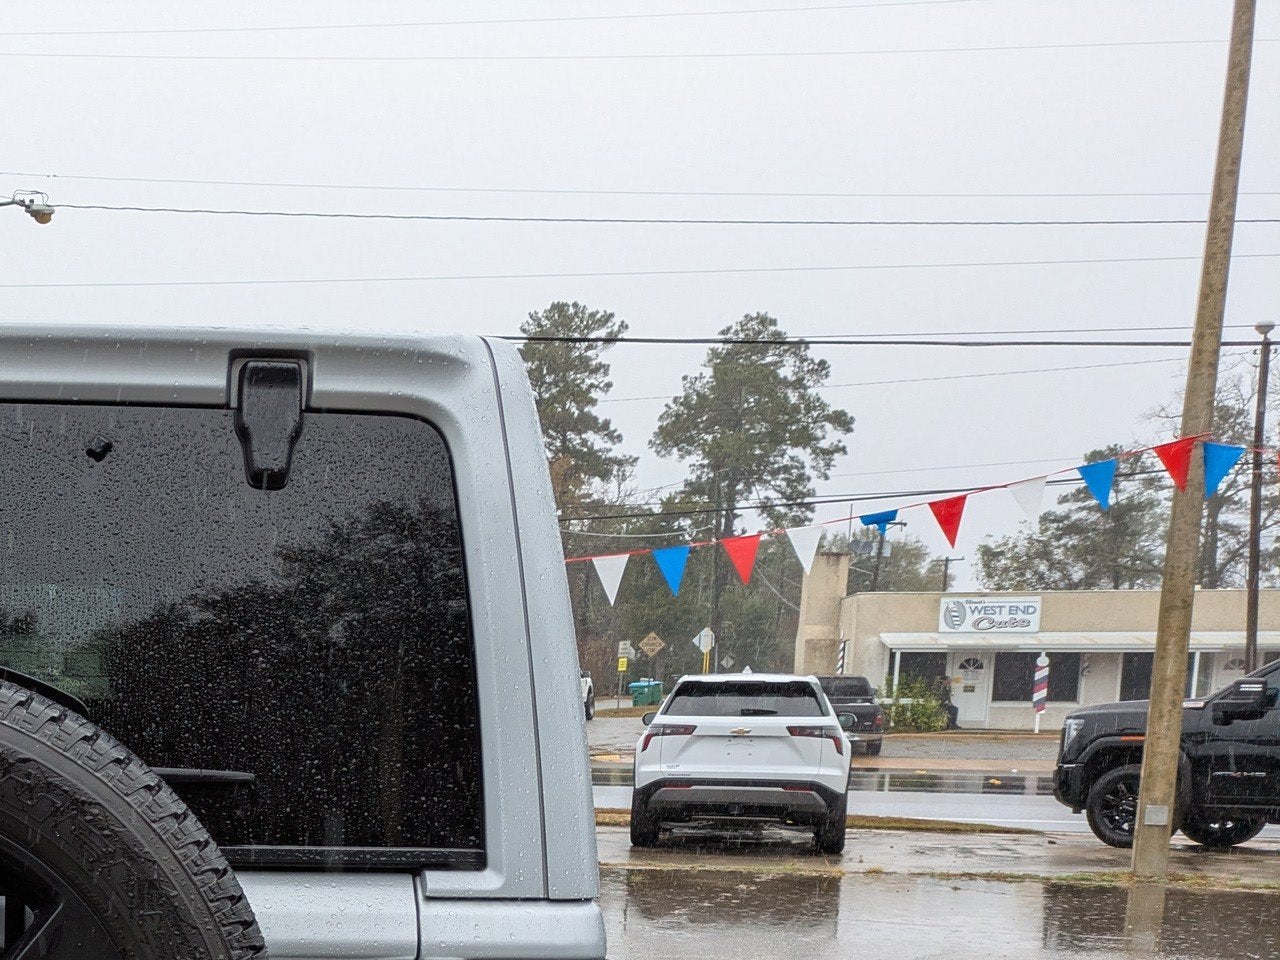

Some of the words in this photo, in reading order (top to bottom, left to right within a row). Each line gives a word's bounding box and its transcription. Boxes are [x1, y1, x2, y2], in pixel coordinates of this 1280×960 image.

[969, 605, 1005, 616] WEST
[1008, 605, 1037, 616] END
[971, 616, 1031, 631] Cuts
